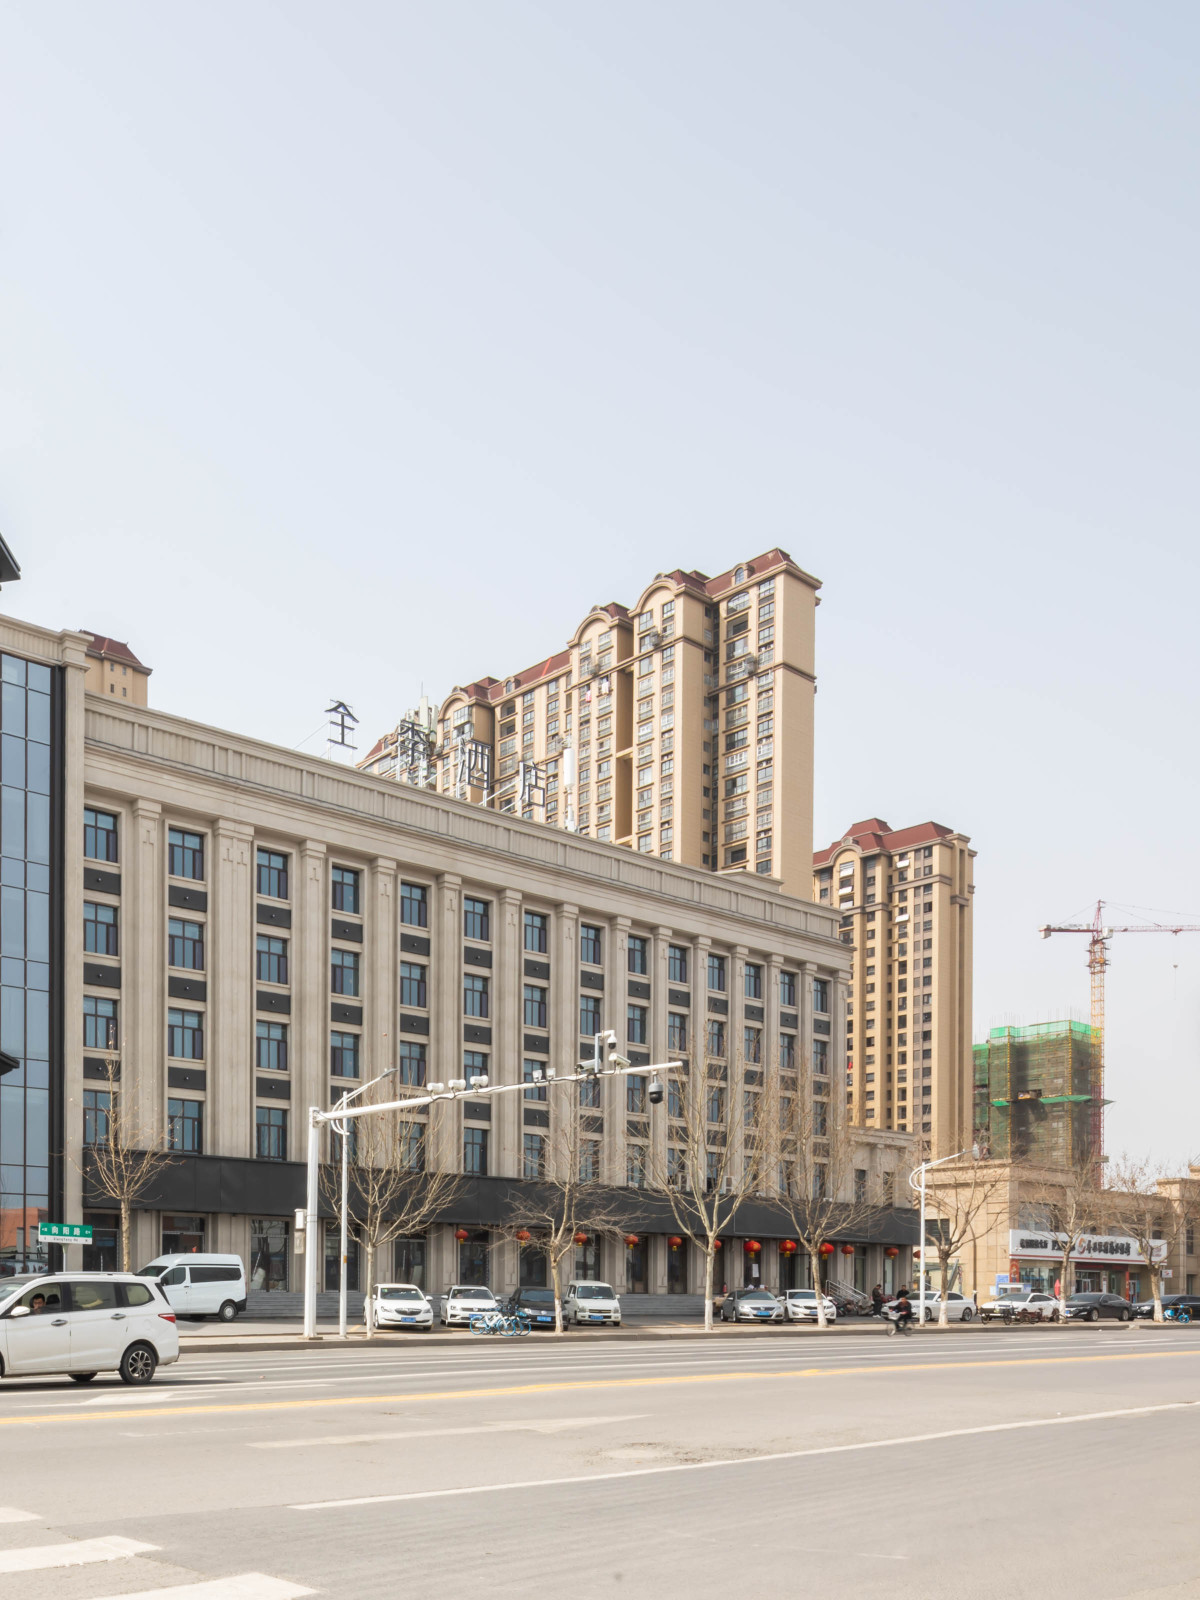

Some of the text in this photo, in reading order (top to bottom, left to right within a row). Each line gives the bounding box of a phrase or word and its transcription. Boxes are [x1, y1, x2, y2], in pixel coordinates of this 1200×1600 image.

[324, 701, 546, 807] 全季酒店
[51, 1226, 80, 1236] 向阳路
